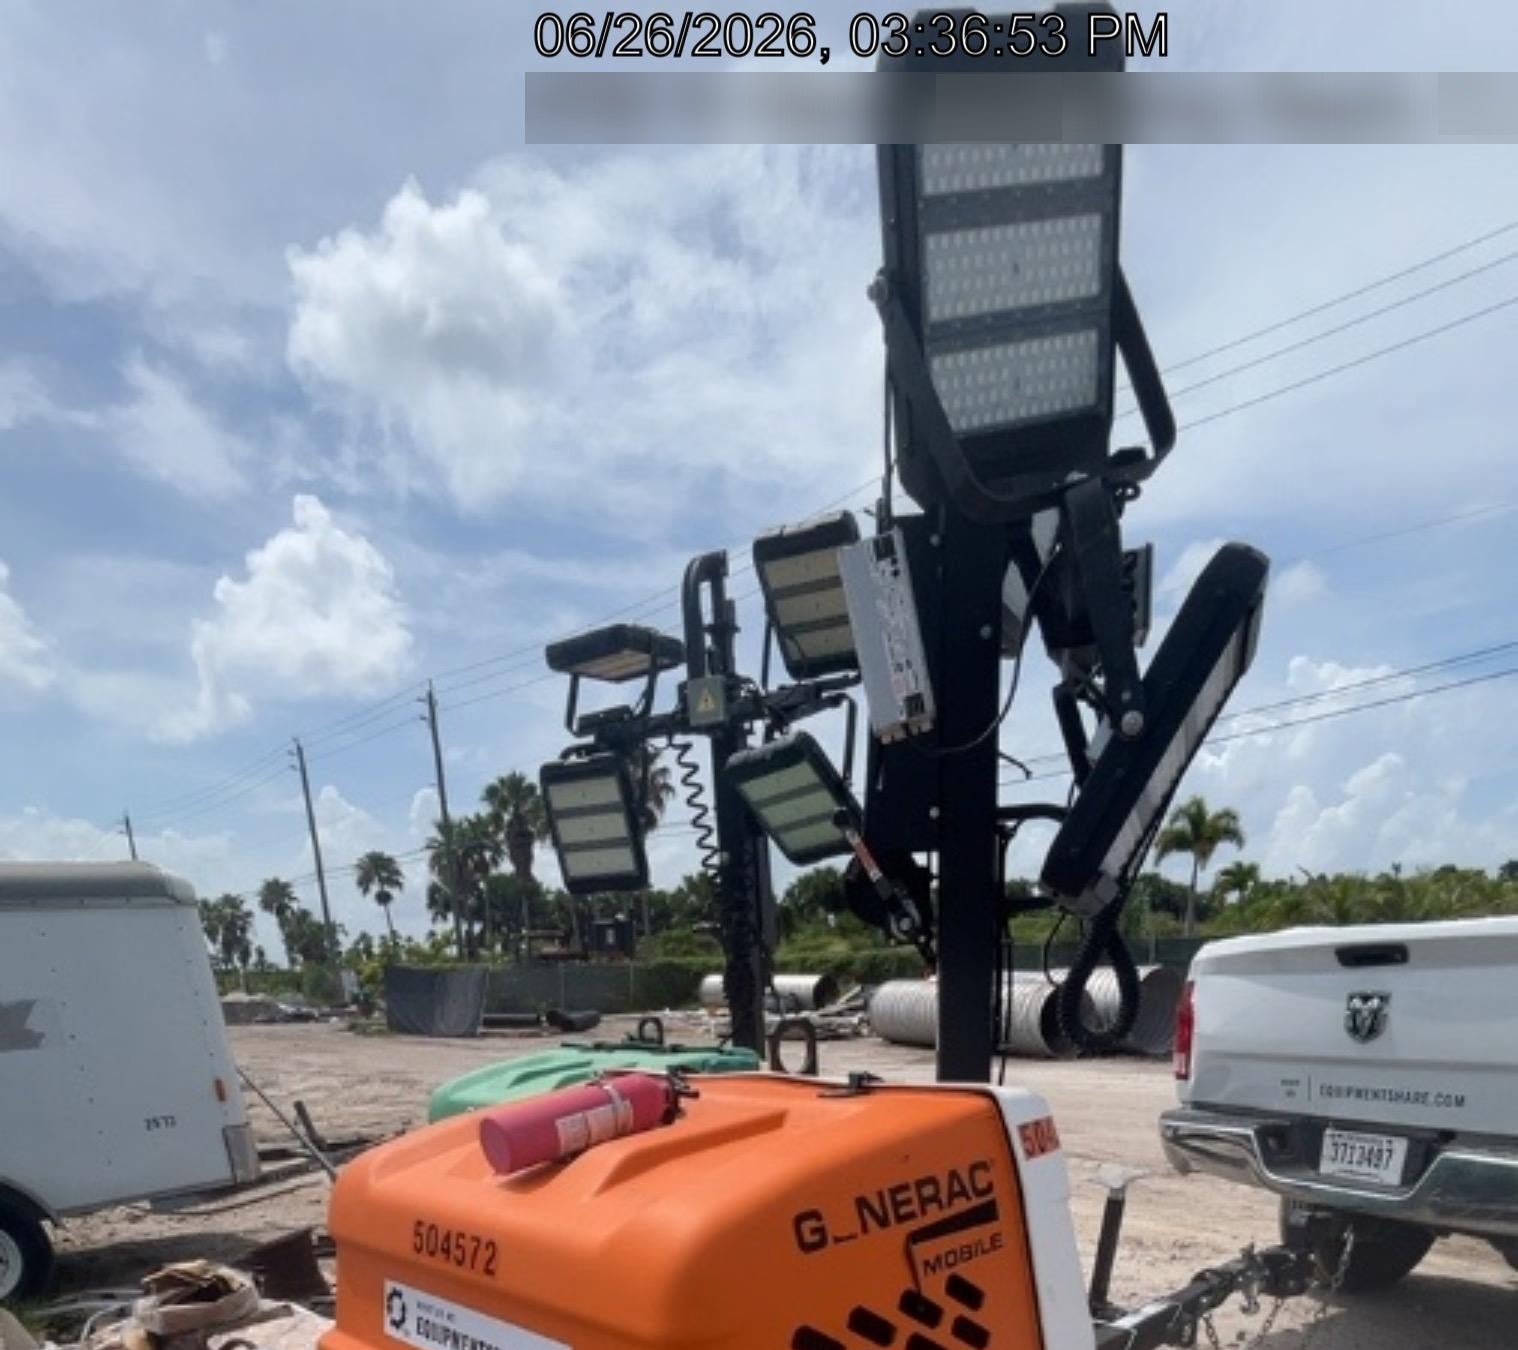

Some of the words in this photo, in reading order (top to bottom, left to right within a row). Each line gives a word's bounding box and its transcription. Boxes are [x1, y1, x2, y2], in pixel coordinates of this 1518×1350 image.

[1319, 1083, 1466, 1107] EQUIPMENTSHARE.COM
[793, 1160, 995, 1254] GNERAC
[413, 1220, 499, 1276] 504572
[922, 1232, 1004, 1276] MOBILE
